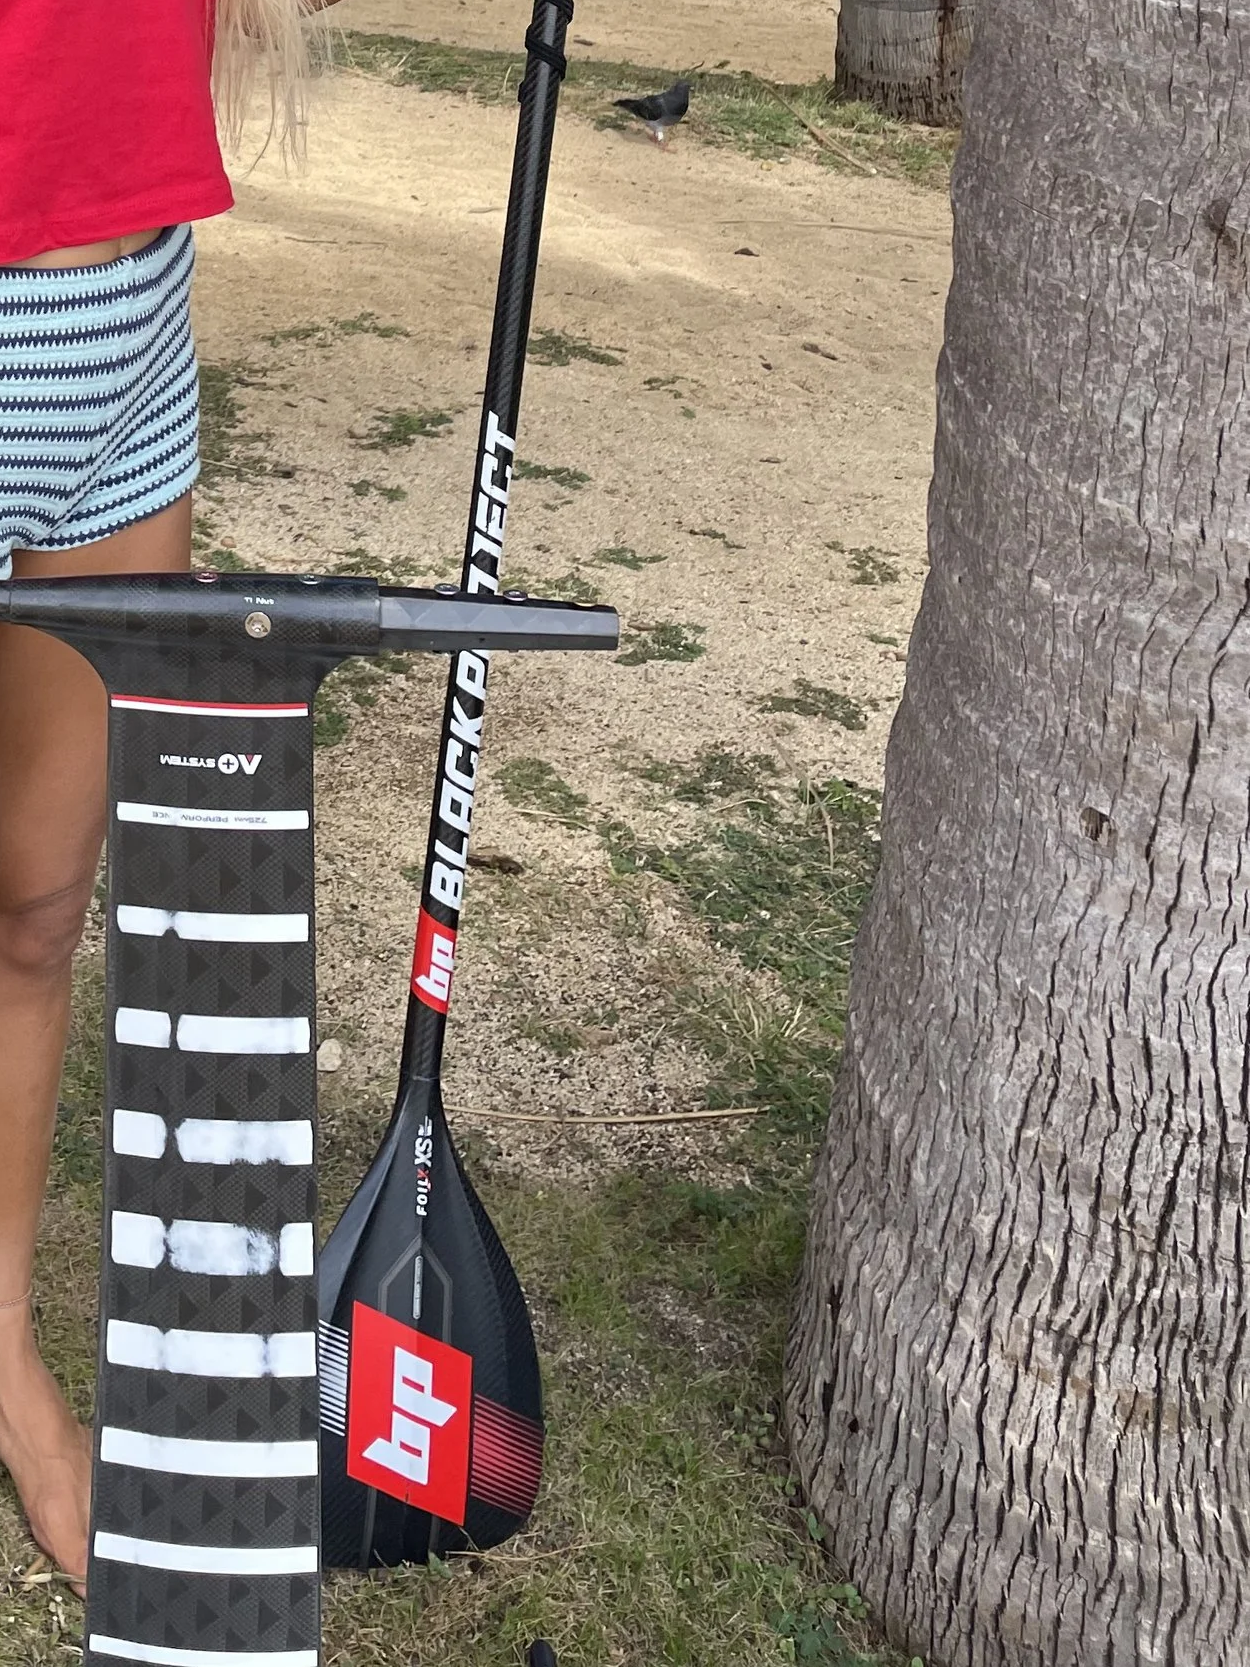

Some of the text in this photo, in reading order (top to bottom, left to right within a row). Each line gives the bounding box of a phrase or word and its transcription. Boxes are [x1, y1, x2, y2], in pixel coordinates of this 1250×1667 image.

[159, 754, 216, 769] SYSTEM
[427, 695, 484, 912] BLACK
[361, 1346, 457, 1486] bp
